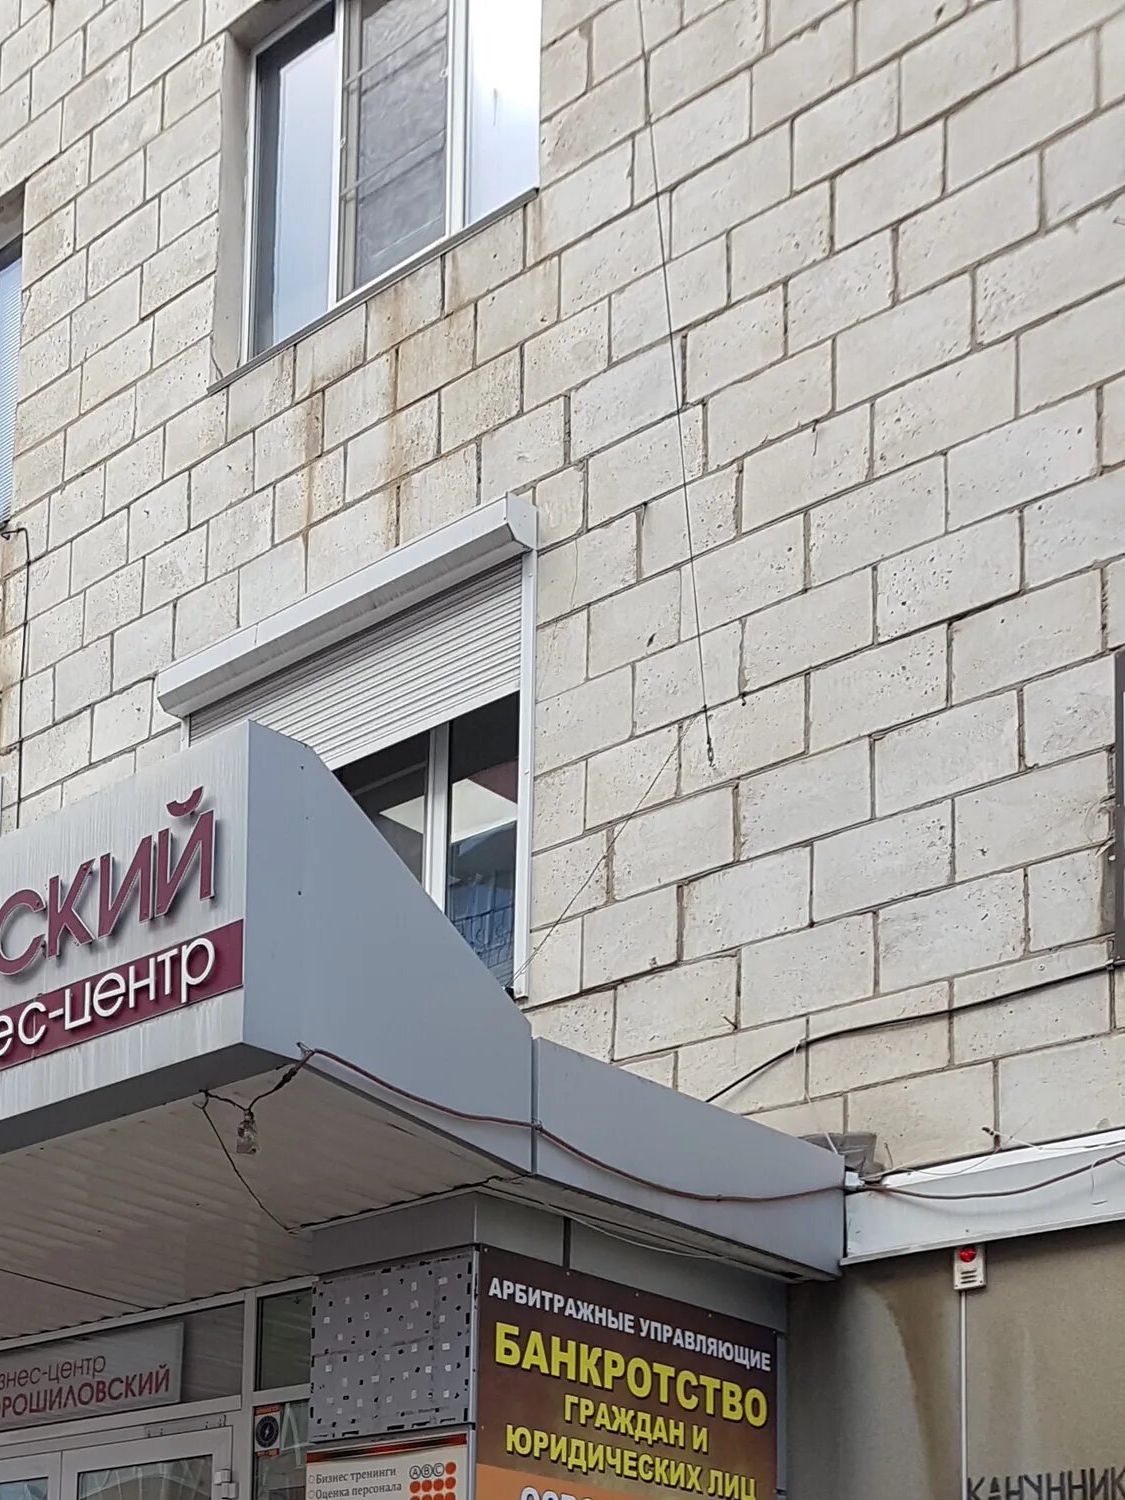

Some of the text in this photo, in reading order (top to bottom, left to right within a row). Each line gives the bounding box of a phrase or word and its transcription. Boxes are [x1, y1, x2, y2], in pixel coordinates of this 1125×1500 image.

[488, 1277, 772, 1372] АРБИТРАЖНЫЕ УПРАВЛЯЮЩИЕ
[494, 1321, 768, 1428] БАНКРОТСТВО
[564, 1394, 708, 1453] ГРАЖДАН И
[316, 1468, 396, 1484] Бизнес тренинги
[506, 1424, 703, 1492] ЮРИДИЧЕСКИХ
[315, 1483, 402, 1500] Оценка персонала
